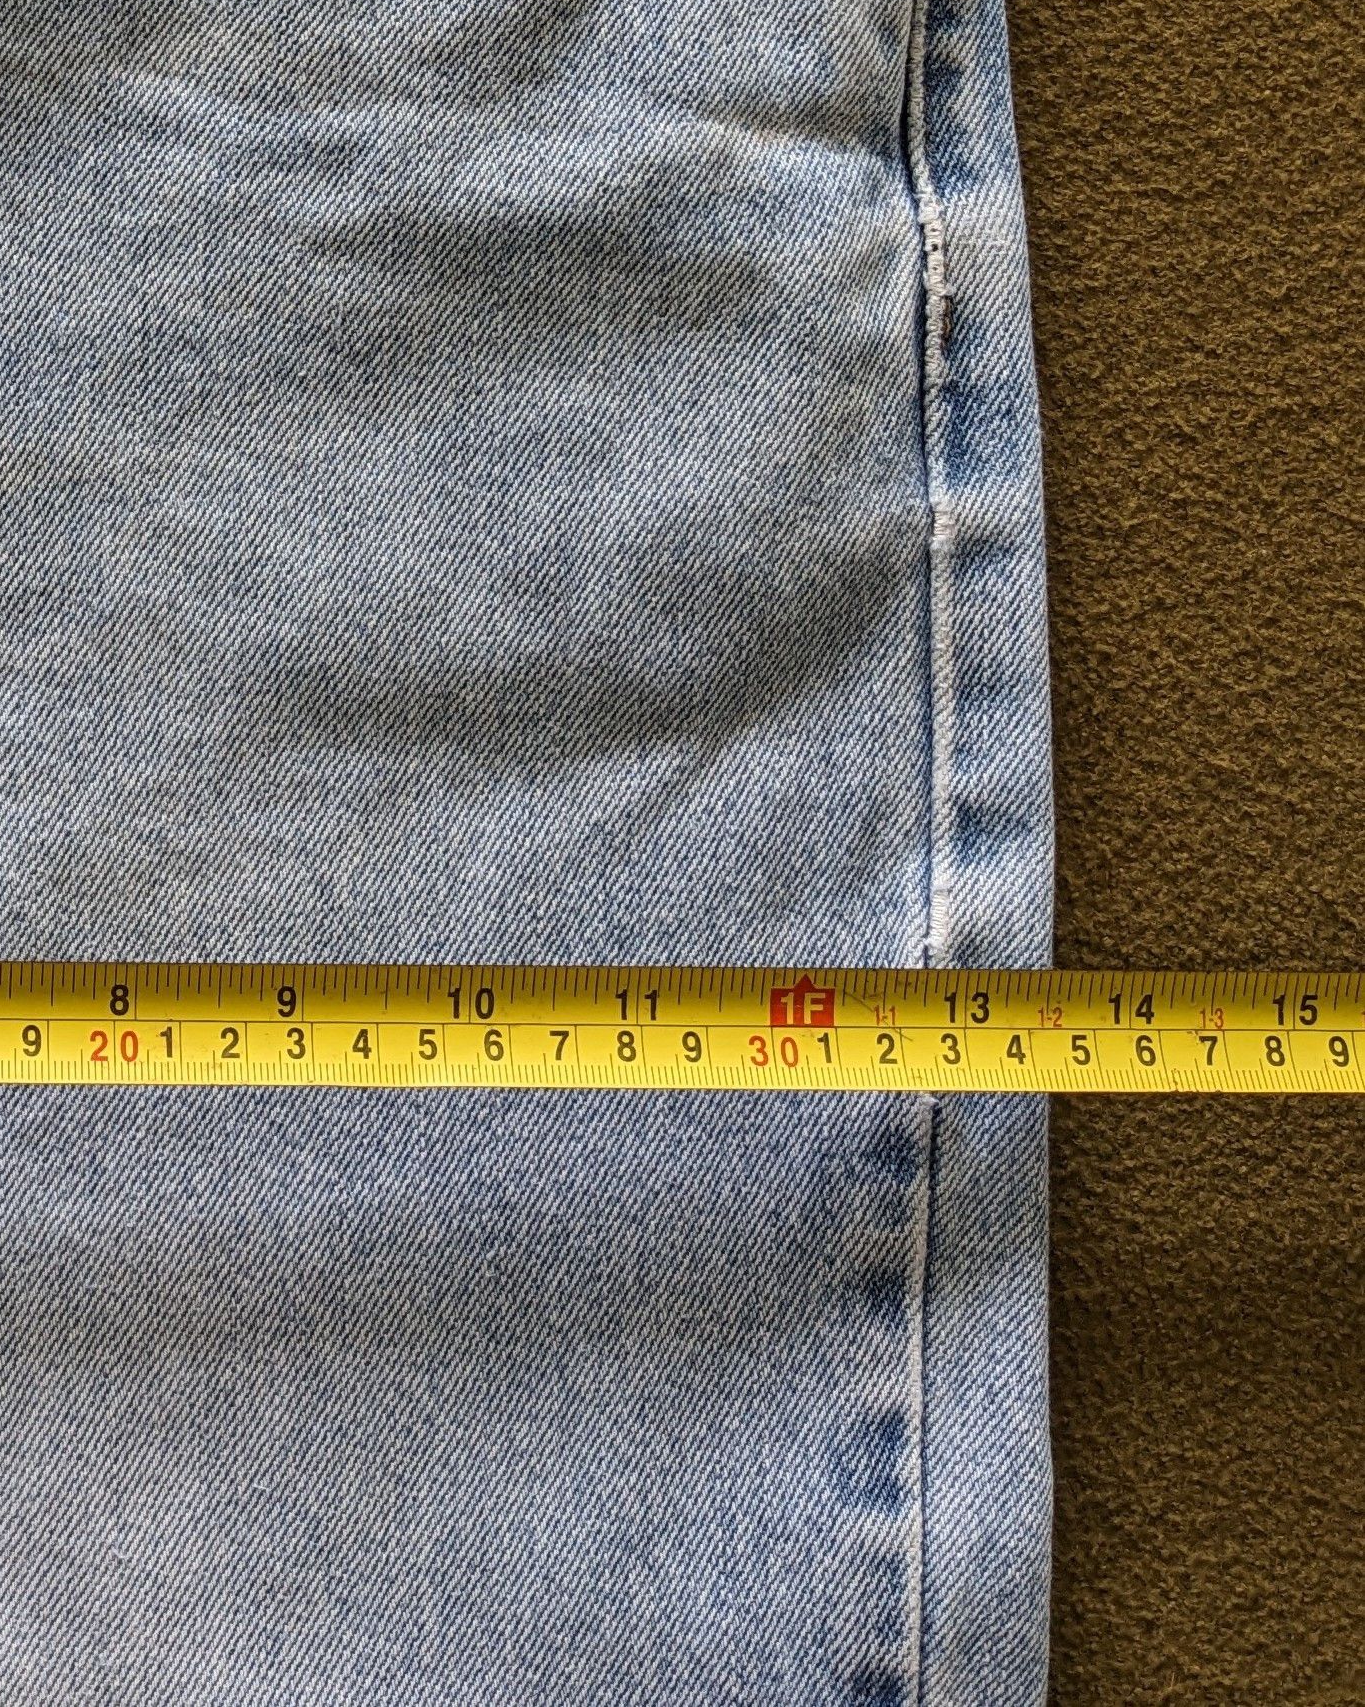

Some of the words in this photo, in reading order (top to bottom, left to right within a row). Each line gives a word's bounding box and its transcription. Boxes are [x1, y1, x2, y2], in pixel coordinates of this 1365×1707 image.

[109, 985, 129, 1014] 8
[277, 987, 297, 1017] 9
[447, 988, 495, 1019] 10
[615, 989, 659, 1020] 11
[944, 992, 990, 1024] 13
[1038, 1008, 1063, 1027] 1-2
[1108, 994, 1155, 1025] 14
[1200, 1008, 1224, 1028] 1-3
[1273, 995, 1318, 1025] 15
[22, 1026, 41, 1056] 9
[90, 1031, 139, 1063] 20
[159, 1028, 173, 1058] 1
[220, 1028, 240, 1058] 2
[286, 1029, 306, 1059] 3
[352, 1029, 372, 1059] 4
[418, 1030, 437, 1060] 5
[484, 1031, 503, 1061] 6
[550, 1031, 570, 1061] 7
[617, 1032, 637, 1062] 8
[682, 1032, 702, 1062] 9
[749, 1036, 799, 1067] 30
[818, 1033, 832, 1063] 1
[876, 1033, 895, 1064] 2
[942, 1034, 961, 1064] 3
[1006, 1035, 1025, 1064] 4
[1071, 1035, 1090, 1065] 5
[1135, 1035, 1156, 1065] 6
[1198, 1036, 1219, 1065] 7
[1265, 1036, 1285, 1066] 8
[1329, 1036, 1350, 1067] 9
